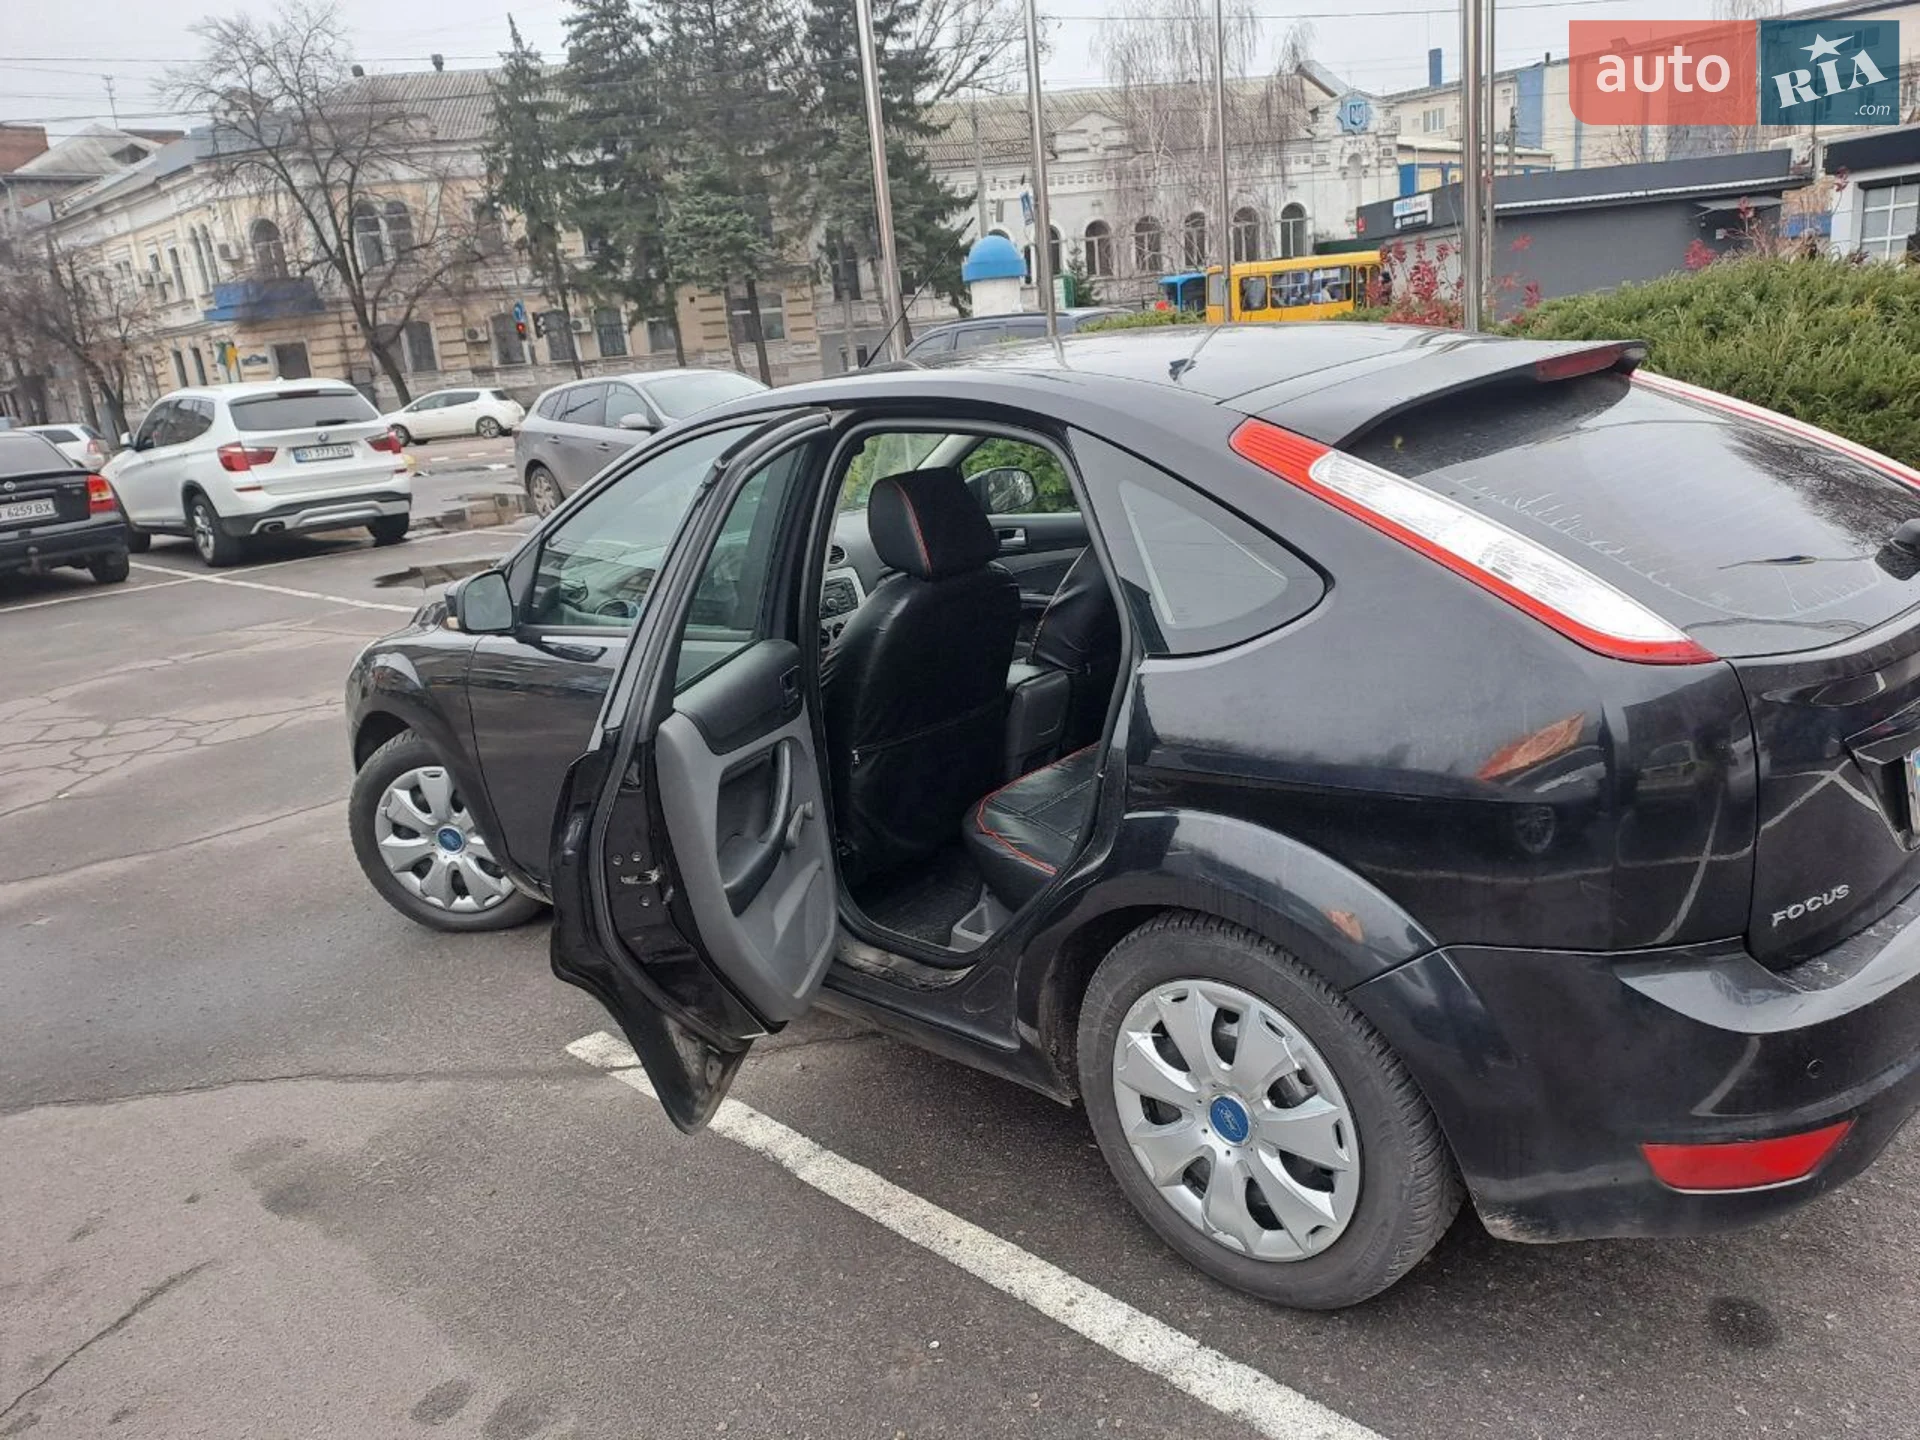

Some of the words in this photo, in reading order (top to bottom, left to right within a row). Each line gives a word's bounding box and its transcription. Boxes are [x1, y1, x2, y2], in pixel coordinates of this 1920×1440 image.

[7, 505, 33, 517] 6259
[35, 503, 51, 514] BX
[1771, 884, 1850, 928] FOCUS
